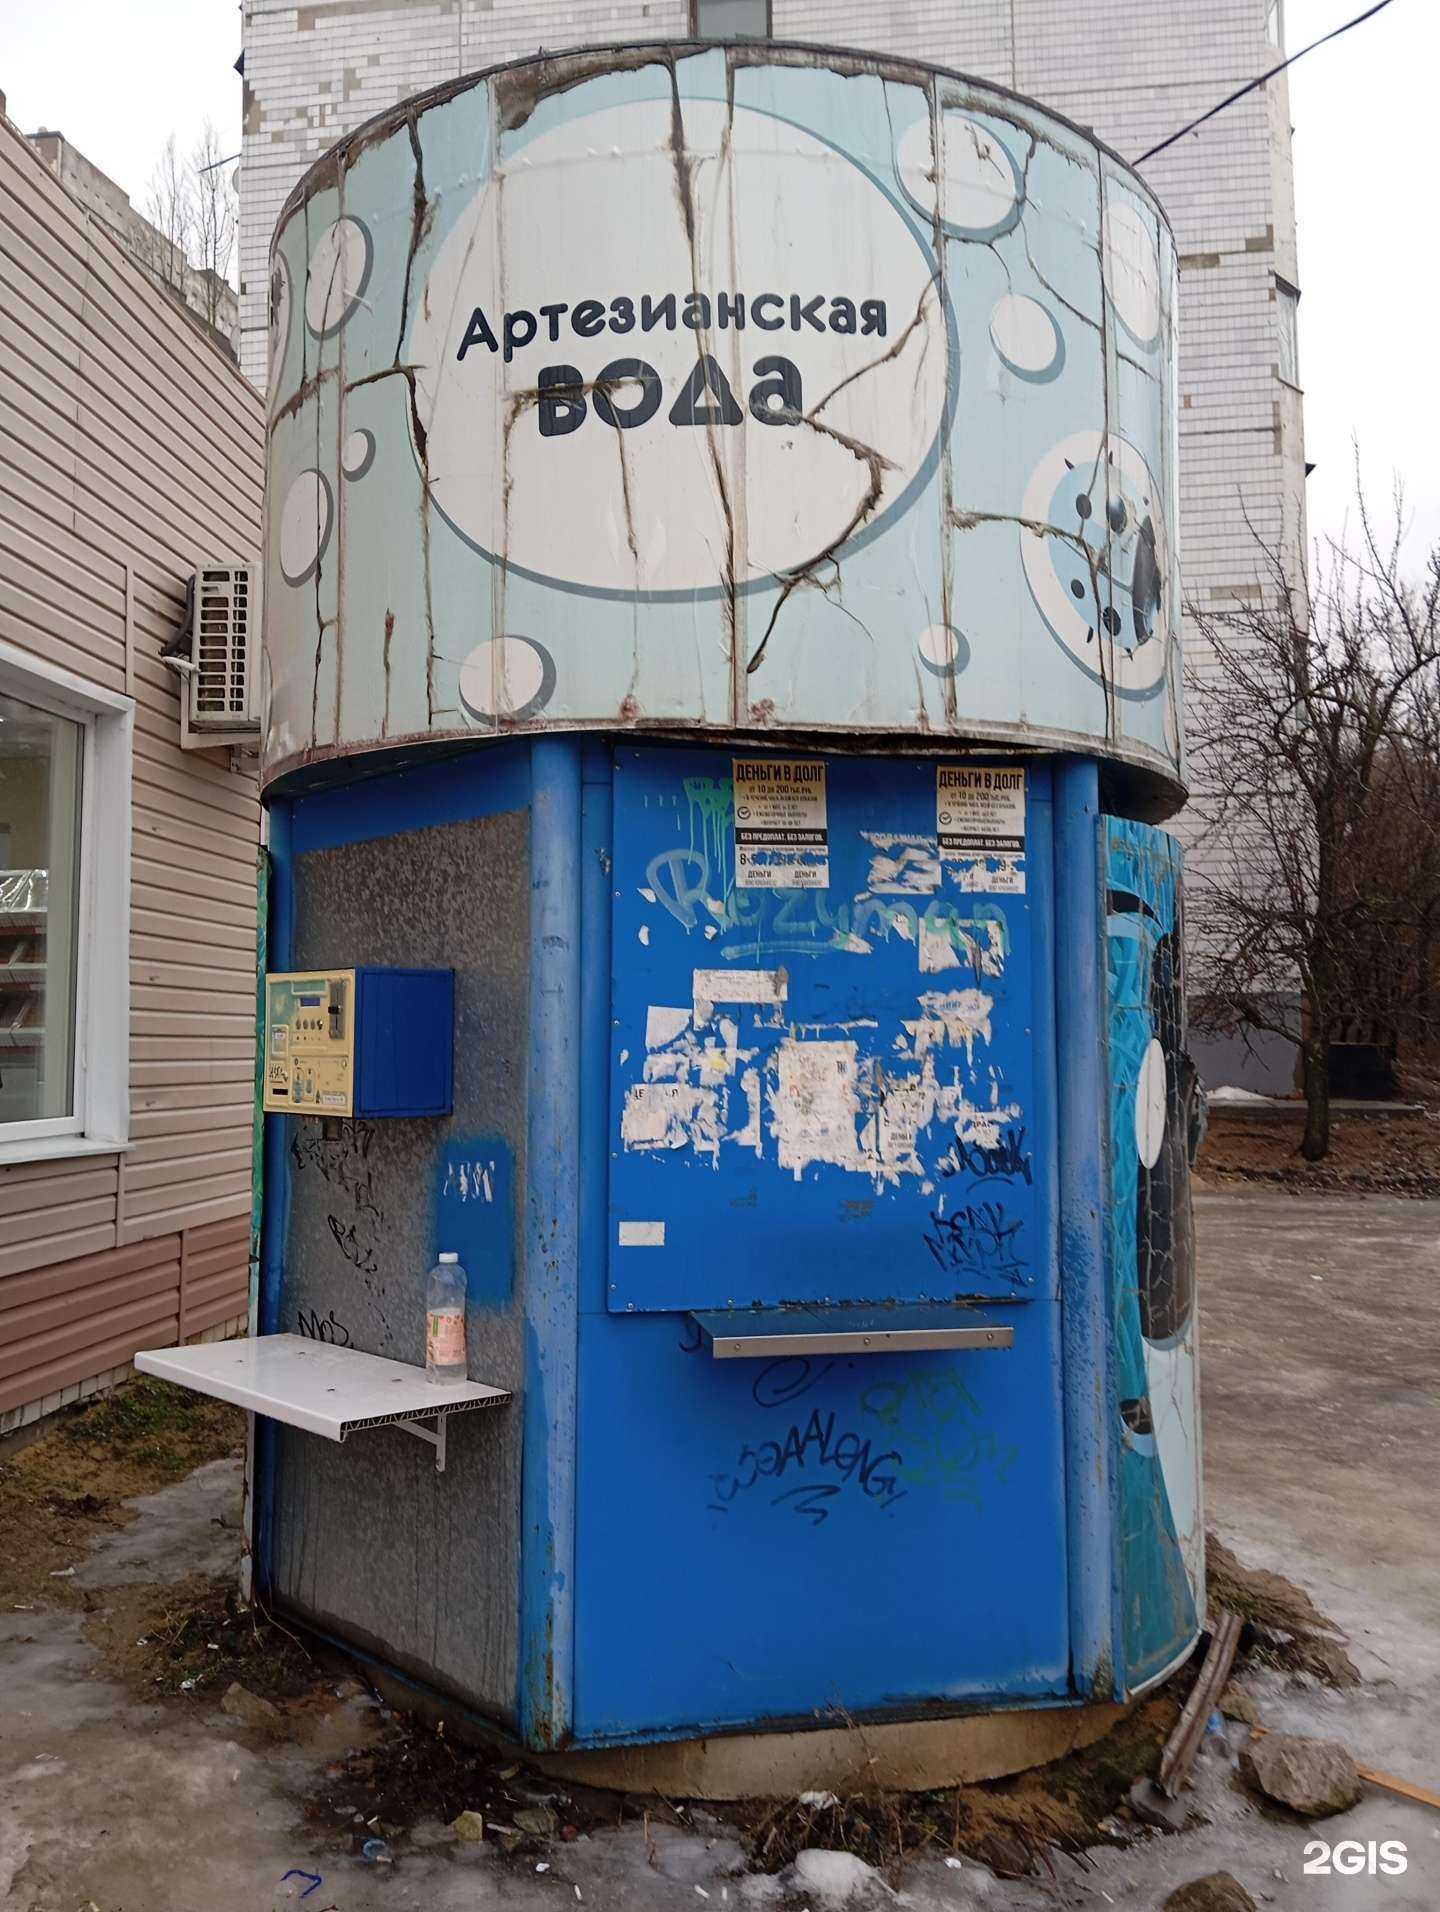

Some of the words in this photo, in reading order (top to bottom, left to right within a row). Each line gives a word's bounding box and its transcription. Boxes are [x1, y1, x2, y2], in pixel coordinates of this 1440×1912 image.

[457, 292, 887, 363] Артезианская
[736, 764, 780, 783] ДЕНЬГИ
[783, 765, 791, 781] В
[794, 765, 824, 784] ДОЛГ
[939, 771, 981, 788] ДЕНЬГИ
[984, 772, 992, 788] В
[993, 773, 1022, 791] ДОЛГ
[757, 785, 766, 794] 10
[776, 785, 790, 794] 200
